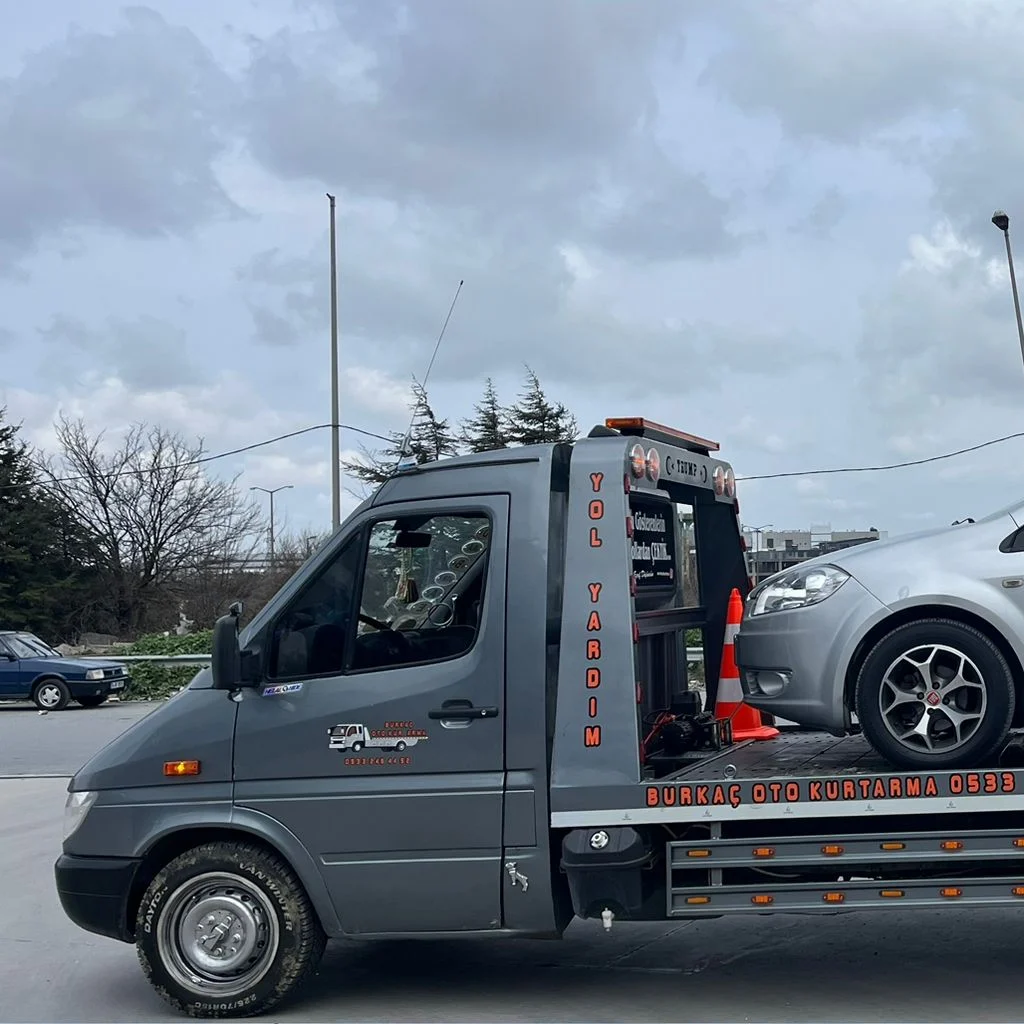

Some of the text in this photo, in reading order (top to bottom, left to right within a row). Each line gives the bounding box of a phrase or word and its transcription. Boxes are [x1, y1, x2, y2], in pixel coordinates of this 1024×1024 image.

[676, 459, 698, 476] TRUMP
[584, 473, 604, 747] YOL YARDIM
[646, 784, 741, 808] BURKAÇ
[752, 781, 800, 805] OTO
[809, 776, 938, 801] KURTARMA
[950, 771, 1015, 794] 0533
